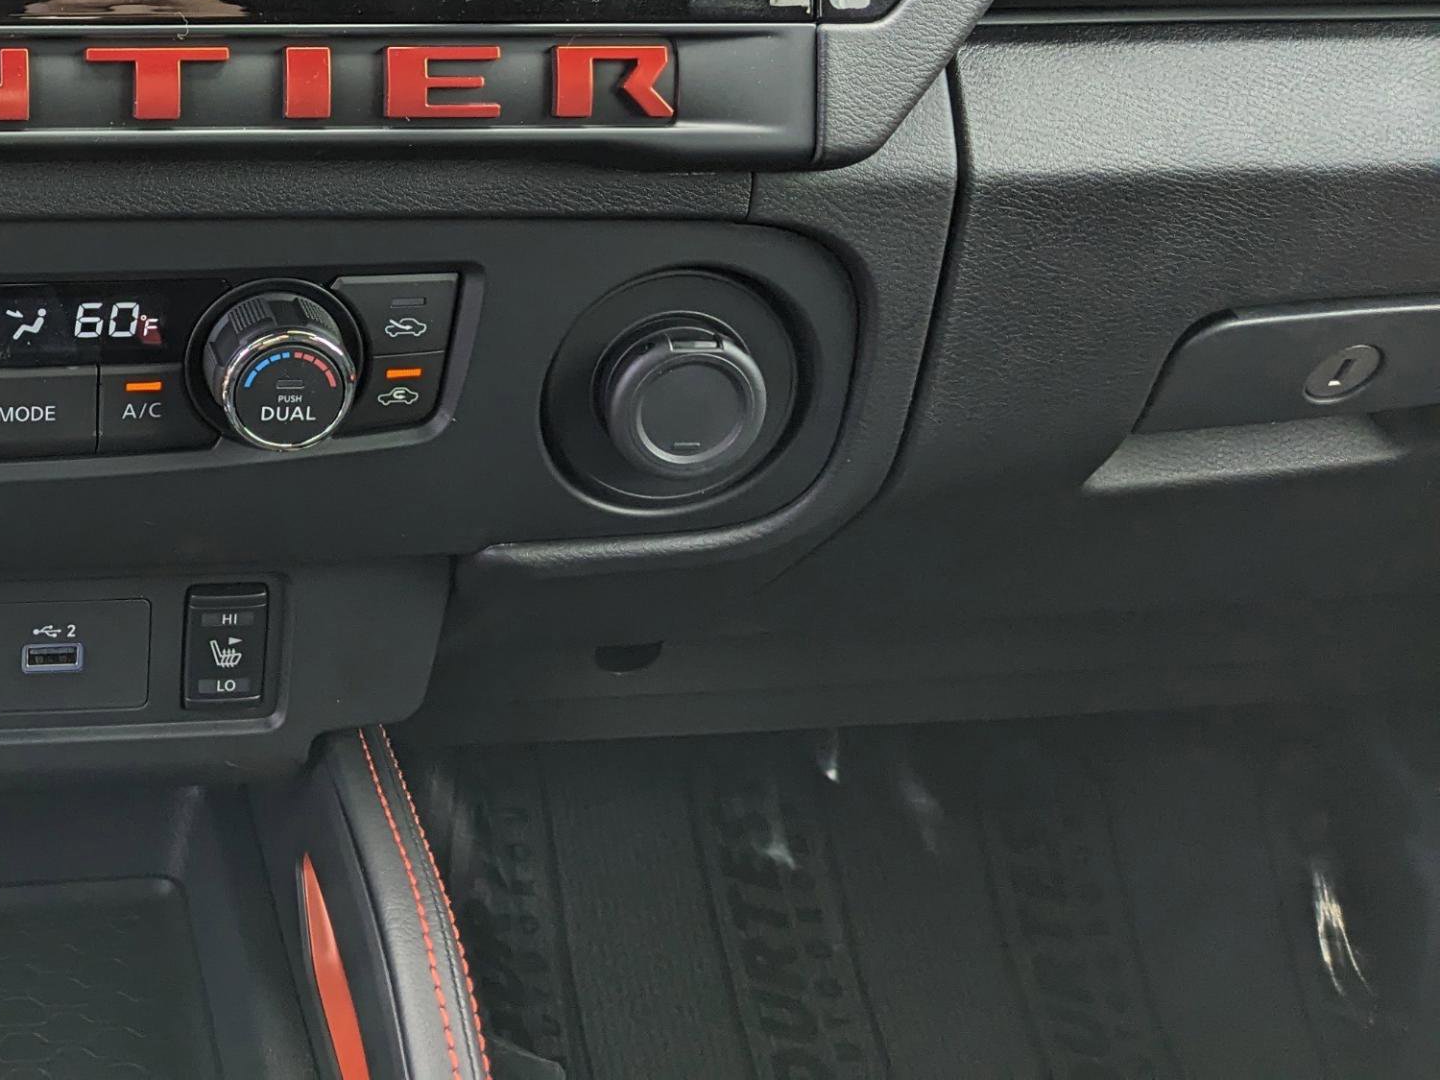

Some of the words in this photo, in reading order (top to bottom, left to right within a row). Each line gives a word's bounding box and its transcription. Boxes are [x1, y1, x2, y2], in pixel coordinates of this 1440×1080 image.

[277, 393, 303, 404] PUSH
[121, 401, 163, 420] A/C
[260, 404, 317, 423] DUAL
[221, 612, 238, 626] HI
[66, 623, 77, 638] 2
[215, 677, 237, 693] LO
